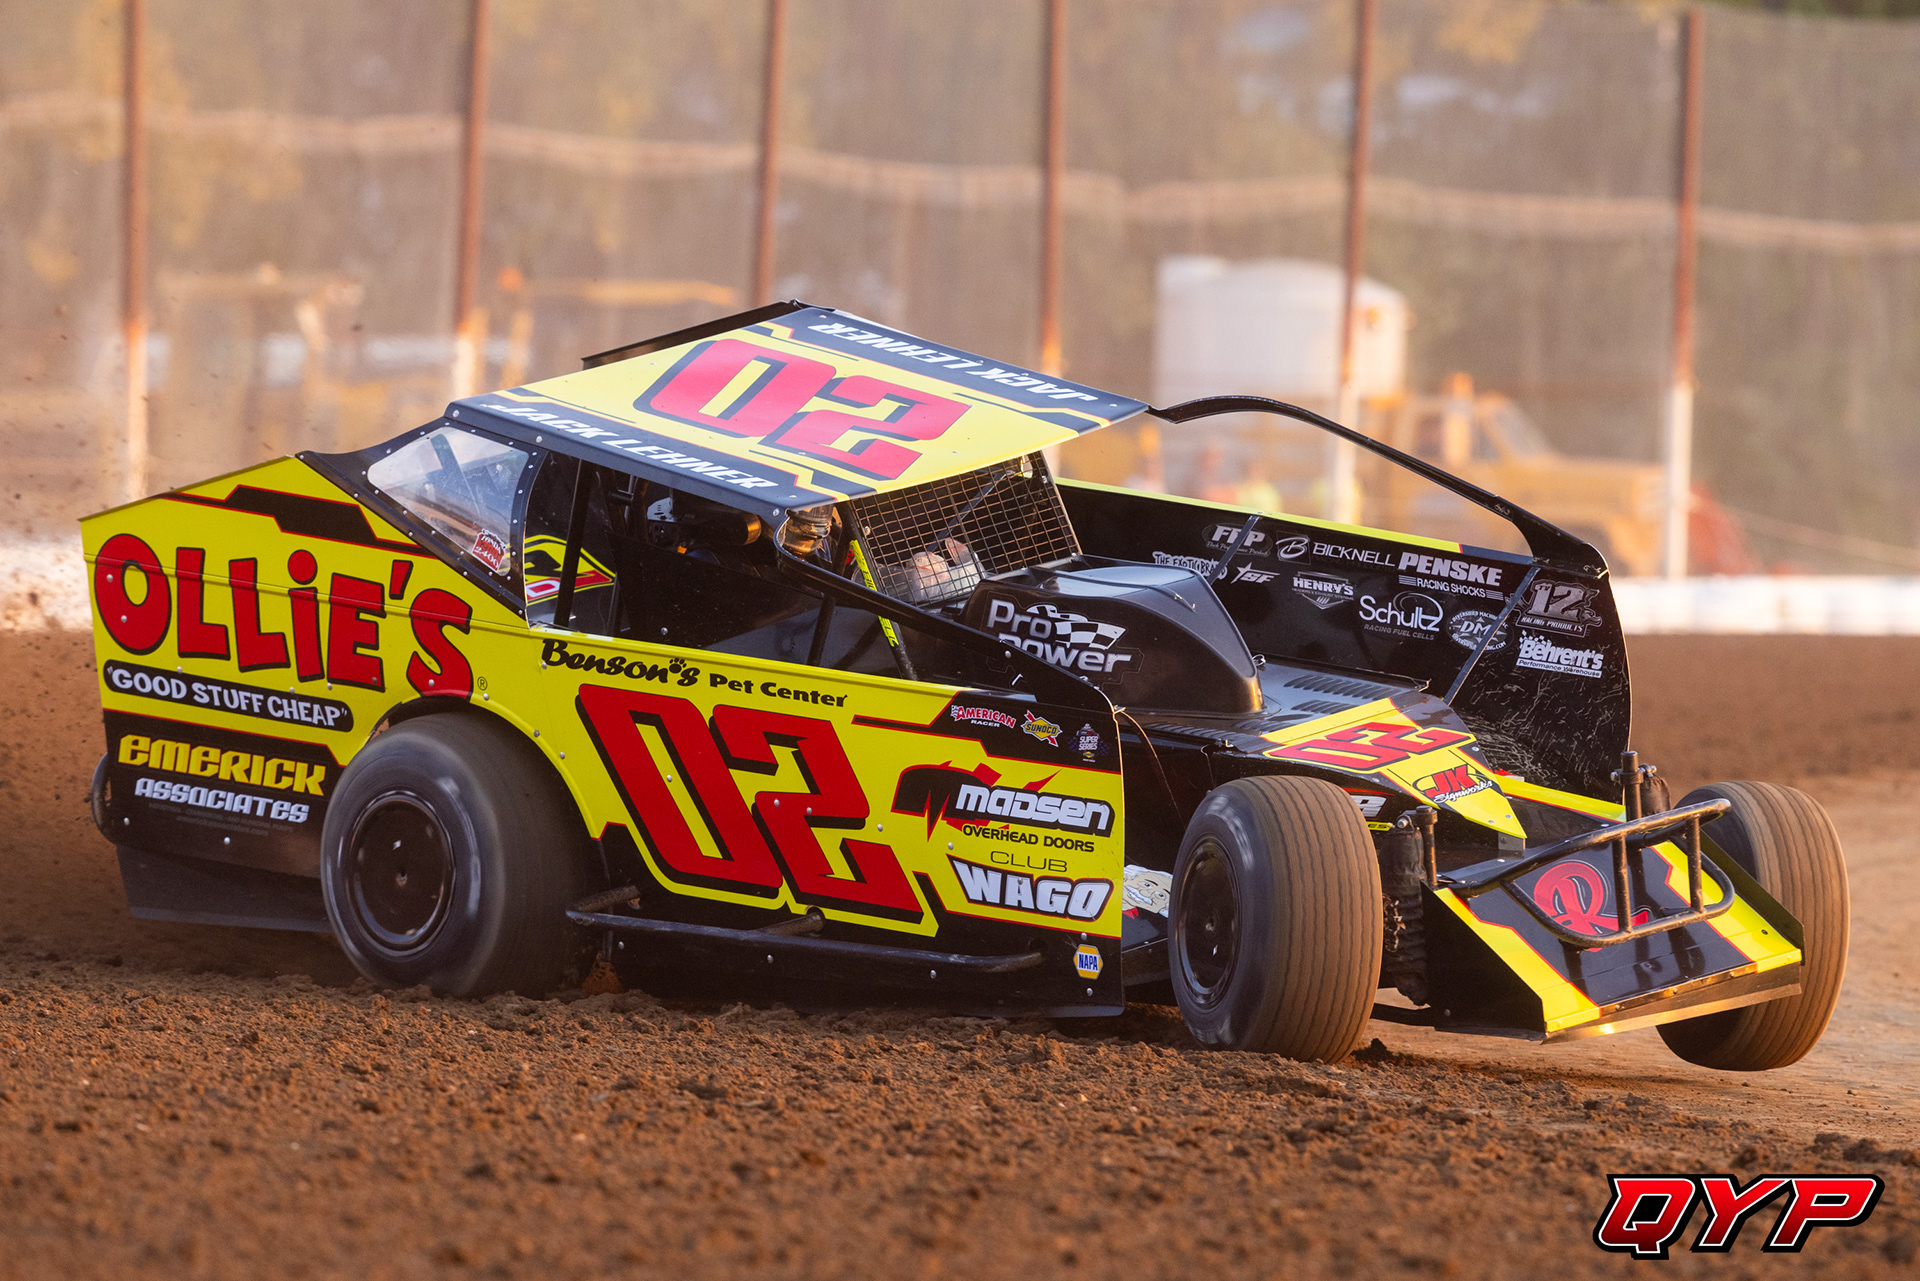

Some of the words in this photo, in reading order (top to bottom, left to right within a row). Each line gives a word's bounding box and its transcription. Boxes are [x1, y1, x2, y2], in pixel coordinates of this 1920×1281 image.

[807, 322, 983, 369] LEHNER
[964, 368, 1099, 401] JACK
[634, 337, 972, 480] 02
[480, 404, 620, 439] JACK
[601, 439, 779, 489] LEHNER
[1312, 541, 1396, 567] BICKNELL
[1398, 551, 1503, 587] PENSKE
[1292, 576, 1354, 596] HENRY'S
[1416, 578, 1450, 592] RACING
[1450, 583, 1486, 598] SHOCKS
[1526, 582, 1586, 622] 12
[986, 599, 1052, 639] Pro
[1359, 594, 1442, 633] Schultz
[1521, 616, 1546, 627] RACING
[1546, 619, 1584, 633] PRODUCTS
[1363, 623, 1392, 634] RACING
[1392, 627, 1411, 637] FUEL
[1412, 631, 1435, 641] CELLS
[1518, 638, 1605, 671] Behrent's
[1518, 659, 1562, 672] Performance
[1563, 663, 1601, 677] Warehouse
[541, 638, 700, 687] Benson's
[709, 672, 755, 694] Pet
[760, 682, 848, 708] Center
[191, 682, 265, 714] STUFF
[954, 706, 1017, 729] AMERICAN
[970, 719, 1001, 728] RACER
[1024, 722, 1058, 736] SUNOCO
[1078, 742, 1098, 751] SERIES
[1079, 735, 1099, 743] SUPER
[1266, 721, 1472, 771] 02
[1423, 763, 1480, 799] JK
[1433, 780, 1494, 804] Signworks
[134, 777, 311, 824] ASSOCIATES
[575, 683, 924, 925] 02
[962, 824, 1039, 845] OVERHEAD
[1043, 835, 1095, 852] DOORS
[990, 850, 1068, 873] CLUB
[952, 859, 1111, 919] WAGO
[1078, 955, 1099, 971] NAPA
